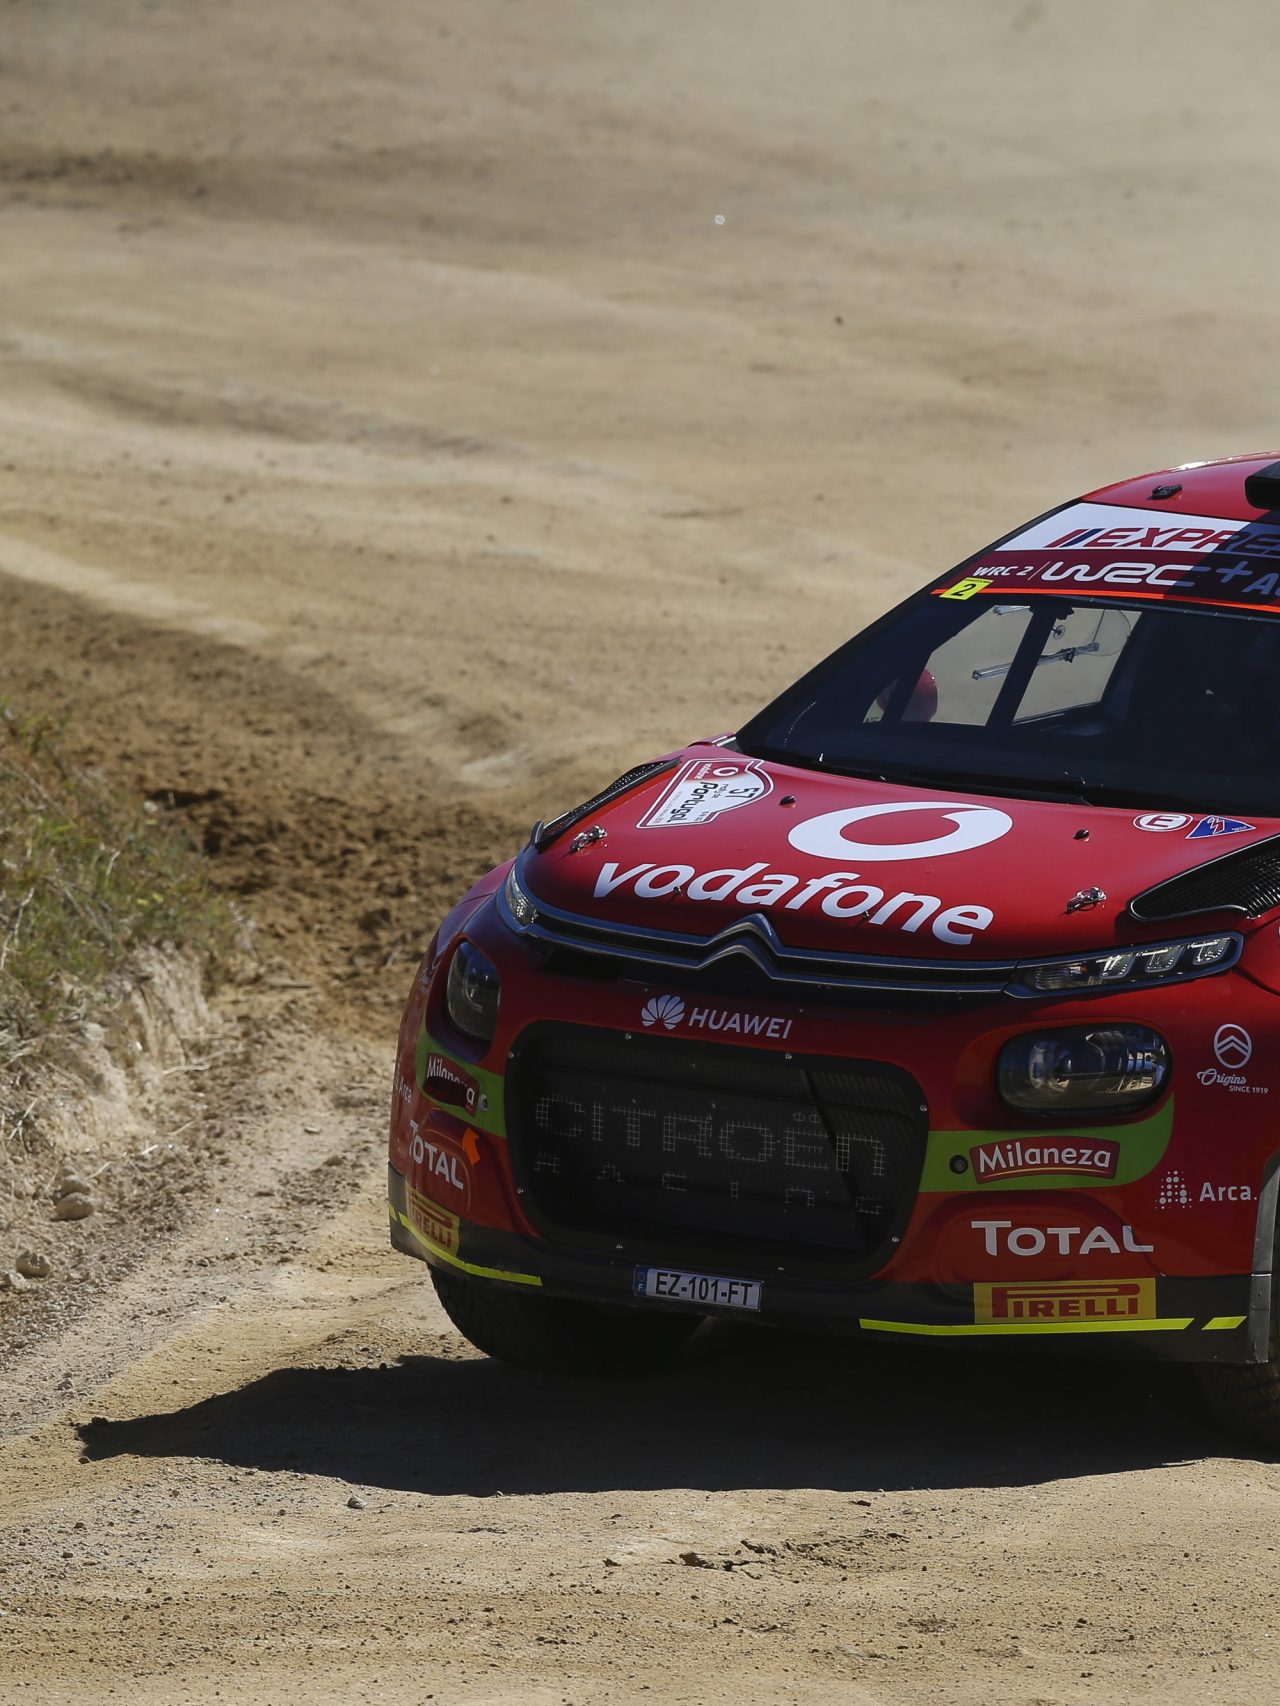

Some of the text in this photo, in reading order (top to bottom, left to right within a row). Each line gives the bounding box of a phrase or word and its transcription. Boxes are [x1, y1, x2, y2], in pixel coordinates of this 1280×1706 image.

[949, 583, 976, 597] 2
[973, 565, 1014, 577] WRC
[1018, 566, 1034, 577] 2
[1041, 561, 1211, 588] WRC
[666, 782, 719, 822] Portugal
[594, 860, 994, 946] vodafone
[688, 1007, 793, 1040] HUAWEI
[427, 1056, 475, 1106] Milana
[1197, 1068, 1246, 1086] Origins
[1229, 1085, 1269, 1094] SINCE 1919
[409, 1119, 464, 1190] TOTAL
[978, 1140, 1112, 1172] Milaneza
[1199, 1182, 1258, 1202] Arca.
[971, 1220, 1154, 1257] TOTAL
[655, 1272, 752, 1306] EZ-101-FT
[991, 1282, 1142, 1319] PIRELLI
